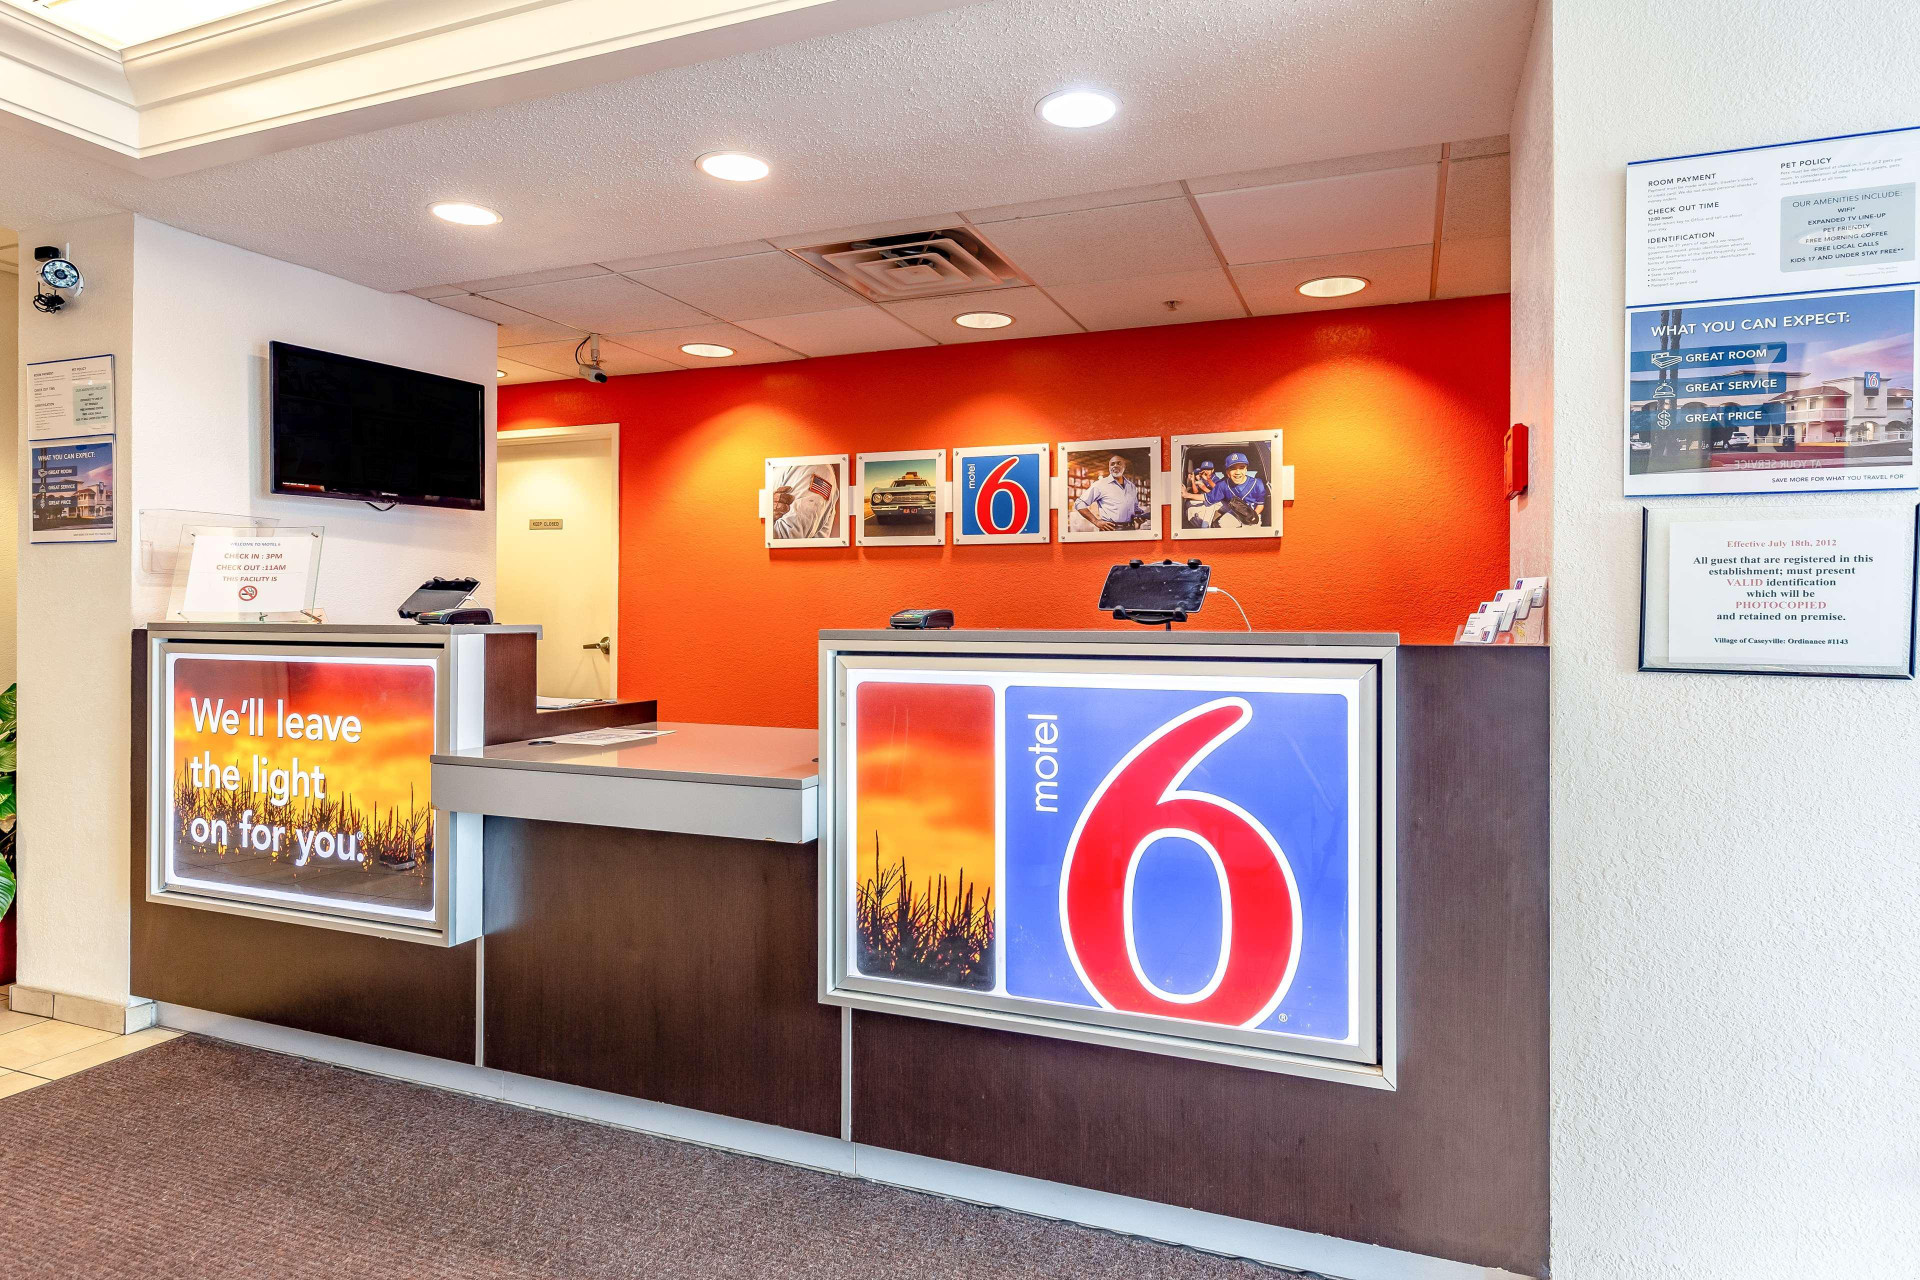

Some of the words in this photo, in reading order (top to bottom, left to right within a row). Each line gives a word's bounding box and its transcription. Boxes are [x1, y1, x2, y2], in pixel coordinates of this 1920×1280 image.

[1780, 161, 1796, 169] PET
[1800, 157, 1832, 167] POLICY
[1648, 179, 1674, 187] ROOM
[1677, 173, 1716, 183] PAYMENT
[1793, 200, 1811, 208] OUR
[1813, 195, 1859, 206] AMENITIES
[1862, 190, 1903, 200] INCLUDE:
[1648, 207, 1676, 215] CHECK
[1808, 217, 1845, 225] EXPANDED
[1859, 212, 1886, 220] LINE-UP
[1837, 223, 1870, 231] FRIENDLY
[1648, 232, 1715, 244] IDENTIFICATION
[1824, 233, 1859, 242] MORNING
[1651, 324, 1697, 337] WHAT
[1701, 321, 1735, 334] YOU
[1741, 317, 1777, 330] CAN
[1783, 311, 1850, 327] EXPECT:
[1685, 352, 1724, 362] GREAT
[1728, 349, 1767, 359] ROOM
[1685, 382, 1725, 393] GREAT
[1728, 379, 1777, 390] SERVICE
[1685, 413, 1724, 423] GREAT
[1728, 410, 1762, 421] PRICE
[968, 463, 976, 489] motel
[975, 455, 1030, 535] 6
[1727, 539, 1766, 548] Effective
[1768, 540, 1787, 549] July
[1790, 540, 1813, 548] 18th,
[1693, 556, 1708, 564] All
[1710, 557, 1737, 566] guest
[1740, 556, 1761, 564] that
[1783, 555, 1836, 565] registered
[1853, 554, 1874, 562] this
[1708, 567, 1783, 576] establishment;
[1815, 567, 1855, 576] present
[1766, 578, 1836, 586] identification
[1747, 590, 1777, 598] which
[1780, 590, 1799, 598] will
[1803, 590, 1815, 598] be
[1736, 601, 1827, 609] PHOTOCOPIED
[1717, 612, 1735, 620] and
[1739, 612, 1781, 621] retained
[1800, 613, 1846, 623] premise.
[1748, 637, 1786, 646] Caseyville:
[191, 697, 264, 736] We'll
[277, 699, 362, 743] leave
[190, 751, 240, 791] the
[253, 754, 325, 806] light
[190, 817, 228, 846] on
[239, 810, 285, 852] for
[1028, 713, 1059, 813] motel
[1058, 696, 1302, 1030] 6
